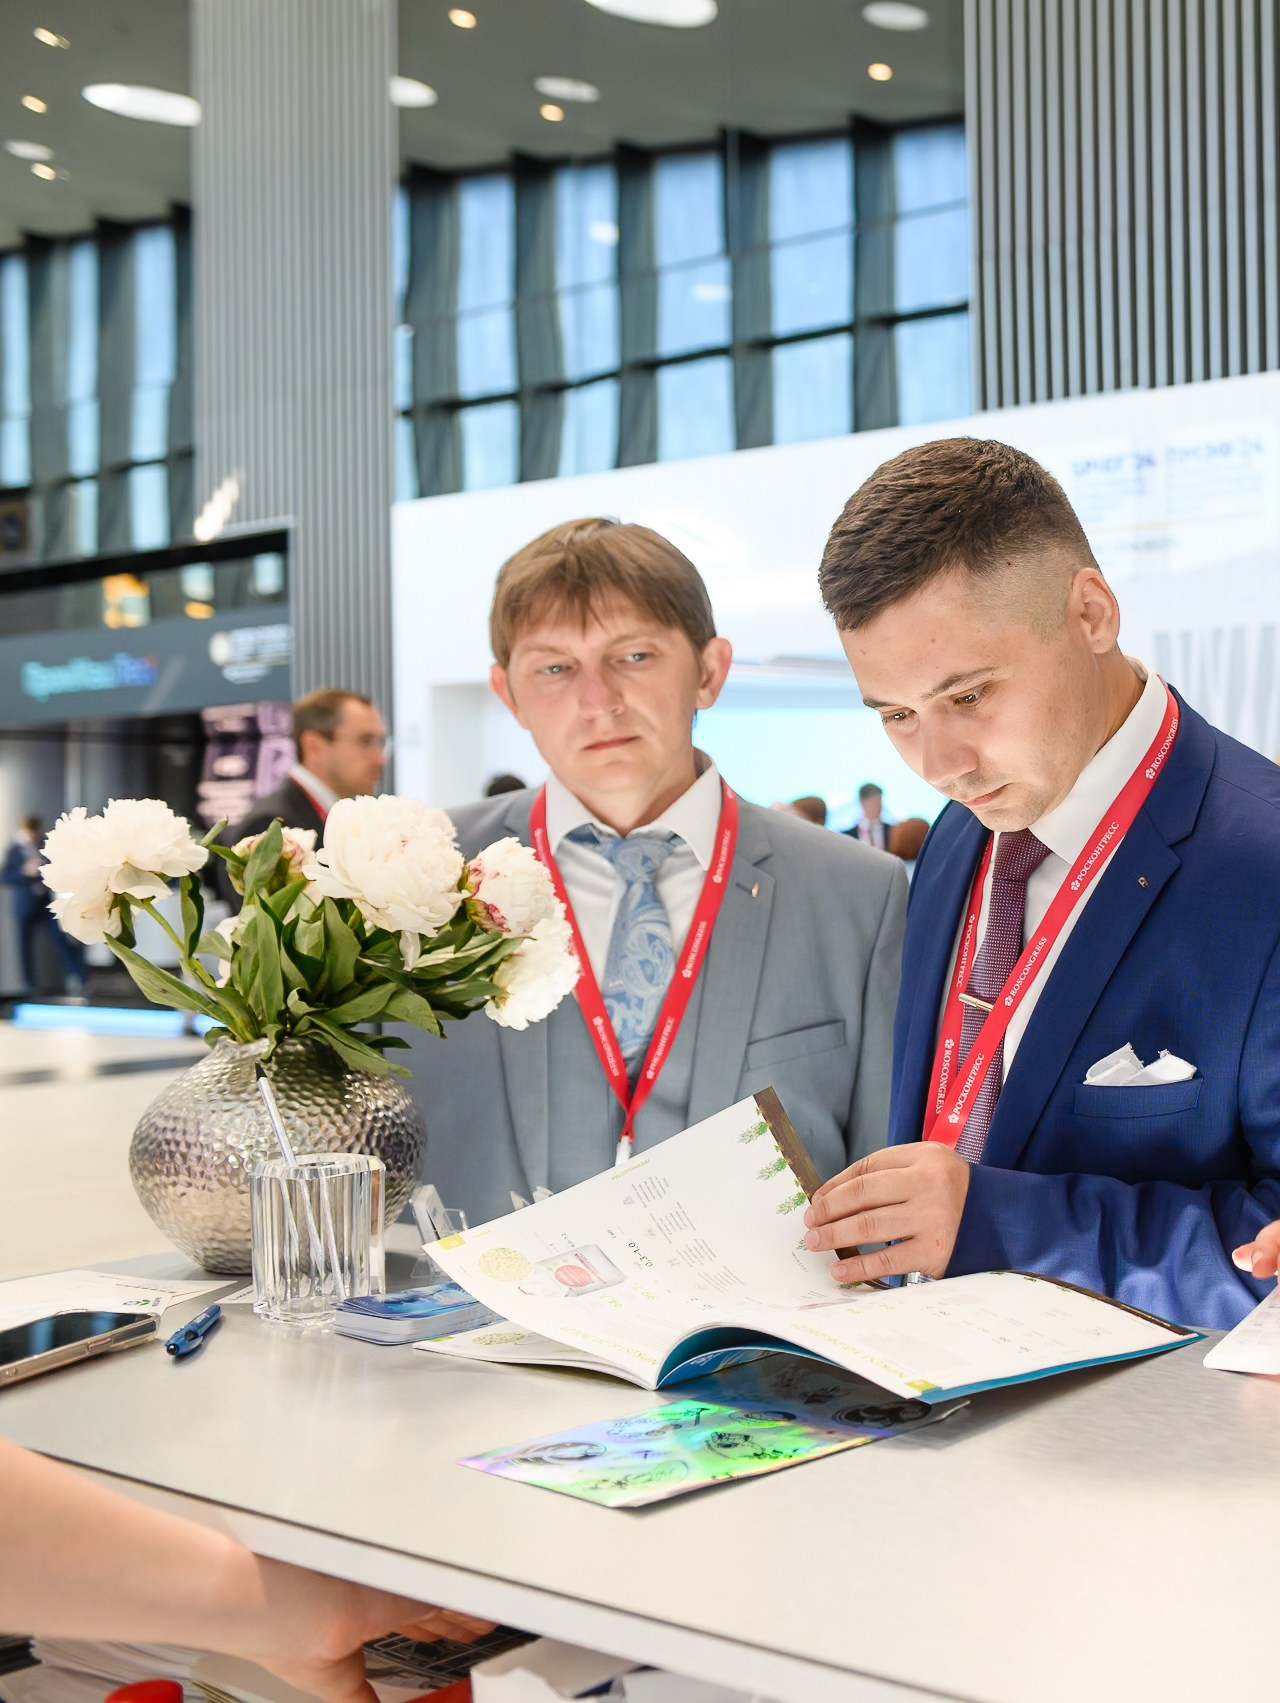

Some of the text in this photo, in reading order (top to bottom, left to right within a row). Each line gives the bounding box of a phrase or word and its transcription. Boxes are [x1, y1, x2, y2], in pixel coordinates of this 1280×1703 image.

[1151, 716, 1179, 770] ROSCONGRESS
[1077, 821, 1120, 882] РОСКОНГРЕСС
[1010, 936, 1047, 997] ROSCONGRESS
[935, 1050, 951, 1115] ROSCONGRESS
[953, 1052, 985, 1115] РОСКОНГРЕСС
